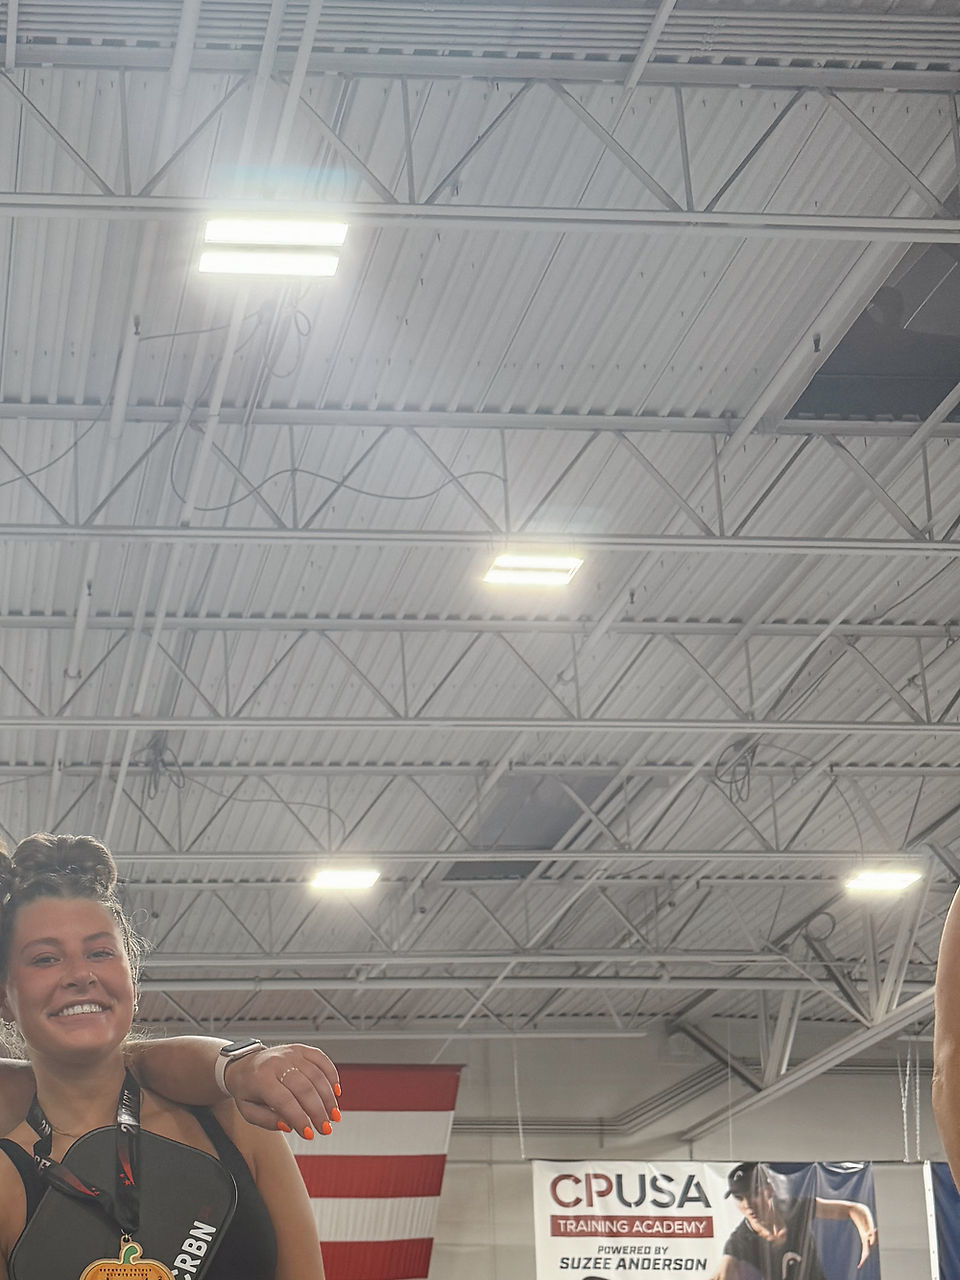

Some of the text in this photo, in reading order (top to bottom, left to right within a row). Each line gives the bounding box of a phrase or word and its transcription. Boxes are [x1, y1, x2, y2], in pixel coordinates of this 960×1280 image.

[550, 1173, 712, 1208] CPUSA
[558, 1219, 707, 1234] TRAINING ACADEMY
[597, 1245, 669, 1255] POWERED BY
[560, 1257, 708, 1271] SUZEE ANDERSON
